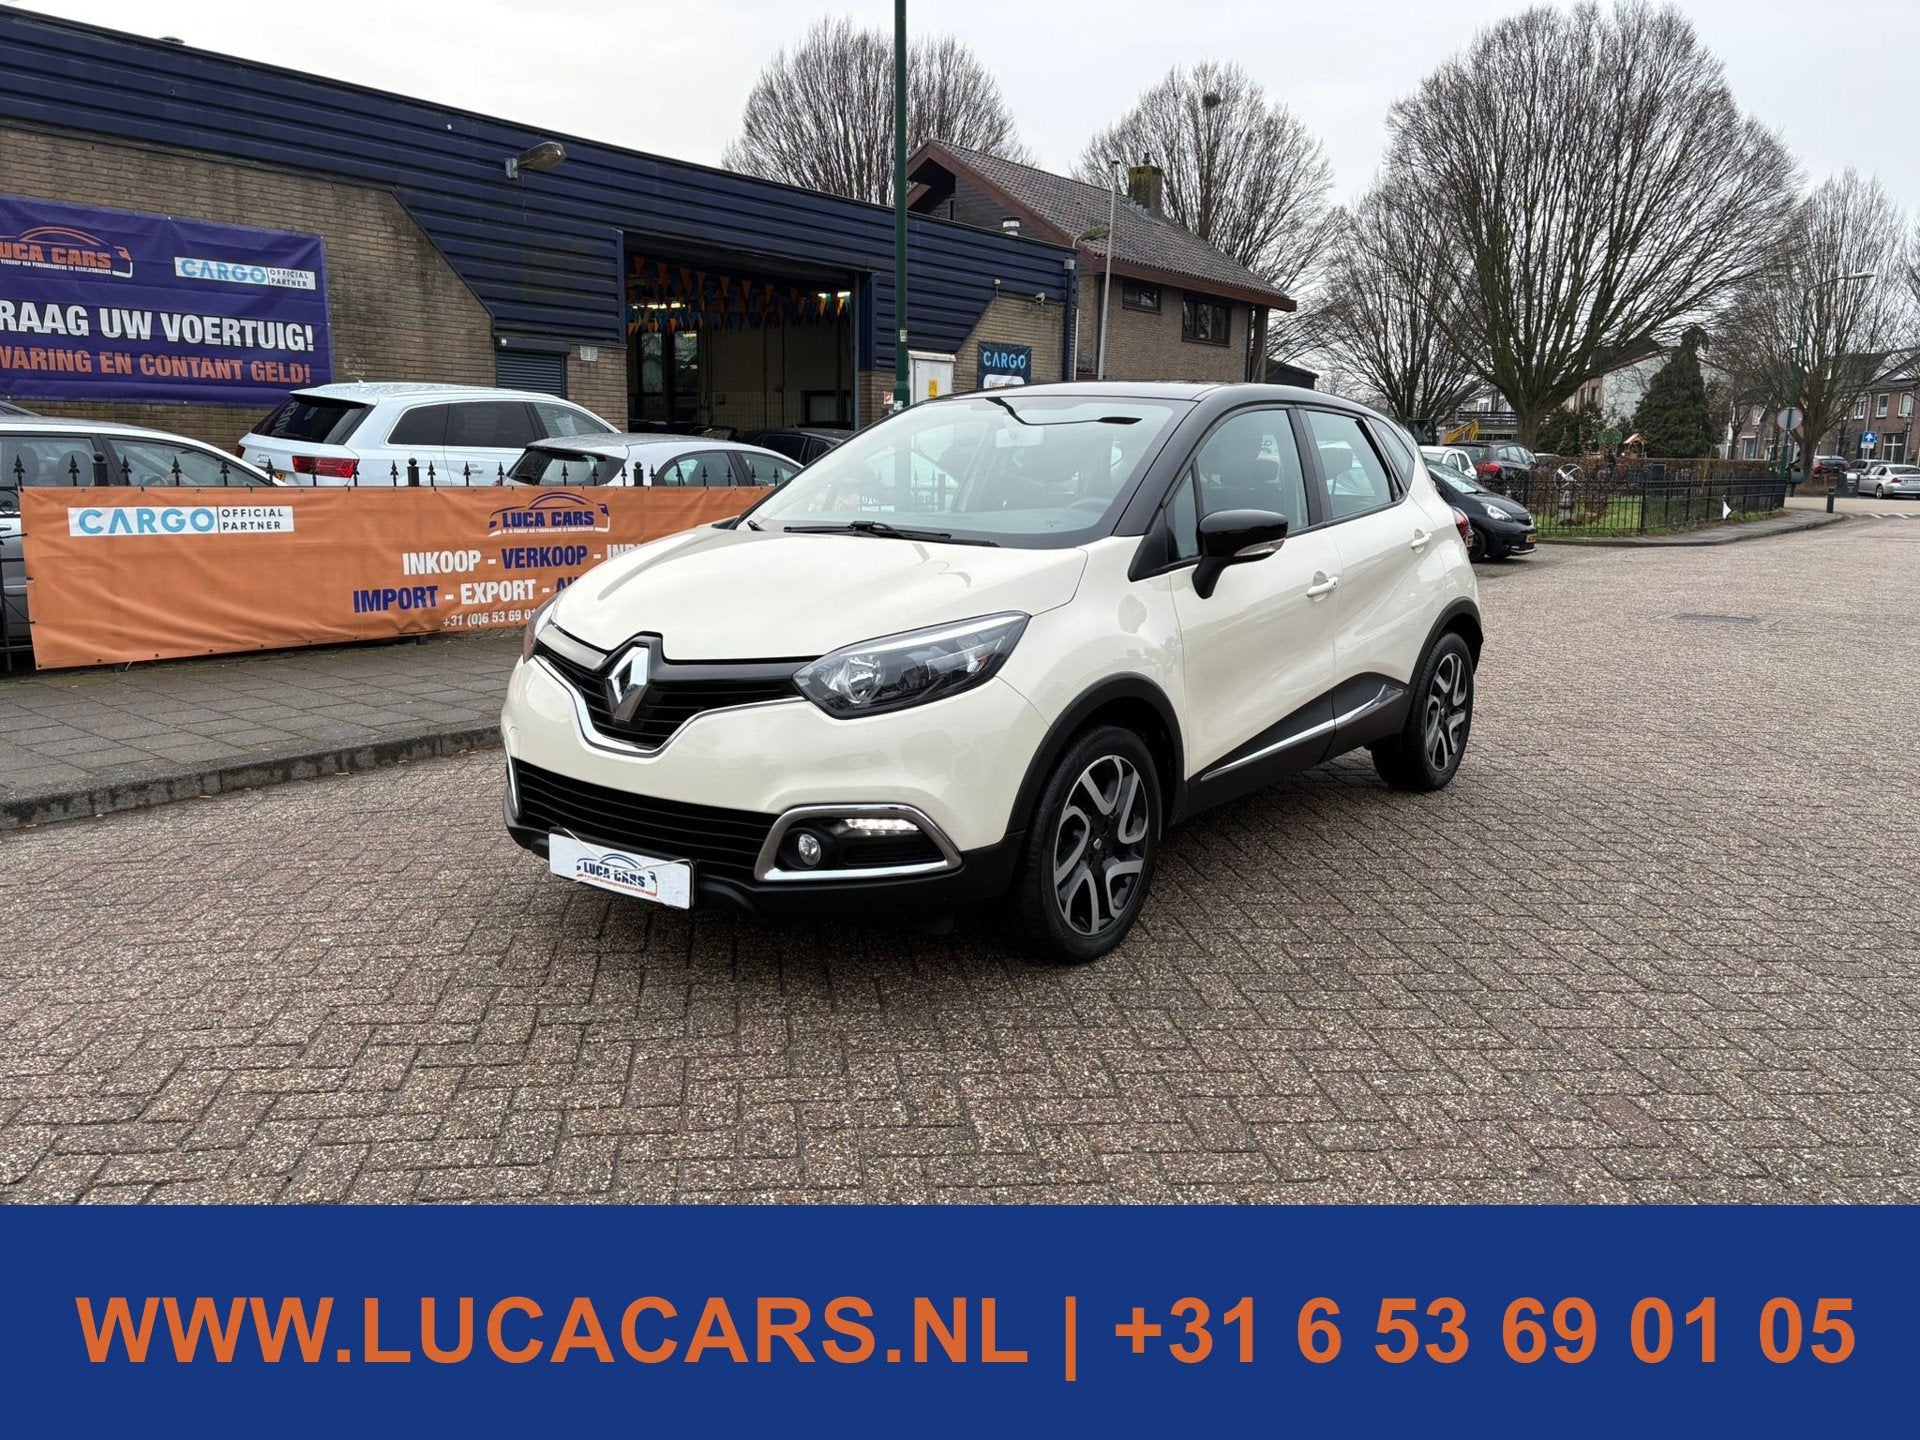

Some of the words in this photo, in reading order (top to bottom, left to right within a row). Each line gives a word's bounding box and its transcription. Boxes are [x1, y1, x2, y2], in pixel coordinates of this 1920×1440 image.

[51, 247, 112, 269] CARS
[180, 259, 267, 283] CARGO
[269, 269, 309, 279] OFFICIAL
[271, 277, 308, 287] PARTNER
[99, 307, 152, 340] UW
[159, 312, 314, 352] VOERTUIG!
[100, 351, 133, 375] EN
[139, 353, 244, 380] CONTANT
[251, 360, 311, 384] GELD!
[983, 351, 1026, 370] CARGO
[78, 508, 215, 535] CARGO
[221, 508, 284, 518] OFFICIAL
[502, 511, 546, 529] LUCA
[551, 510, 595, 528] CARS
[222, 521, 282, 531] PARTNER
[401, 550, 482, 576] INKOOP
[500, 545, 589, 569] VERKOOP
[353, 585, 438, 613] IMPORT
[460, 579, 536, 605] EXPORT
[443, 614, 463, 627] +31
[467, 612, 489, 627] (0)6
[491, 611, 506, 623] 53
[508, 610, 521, 622] 69
[584, 862, 611, 879] LUCA
[614, 870, 646, 888] CARS
